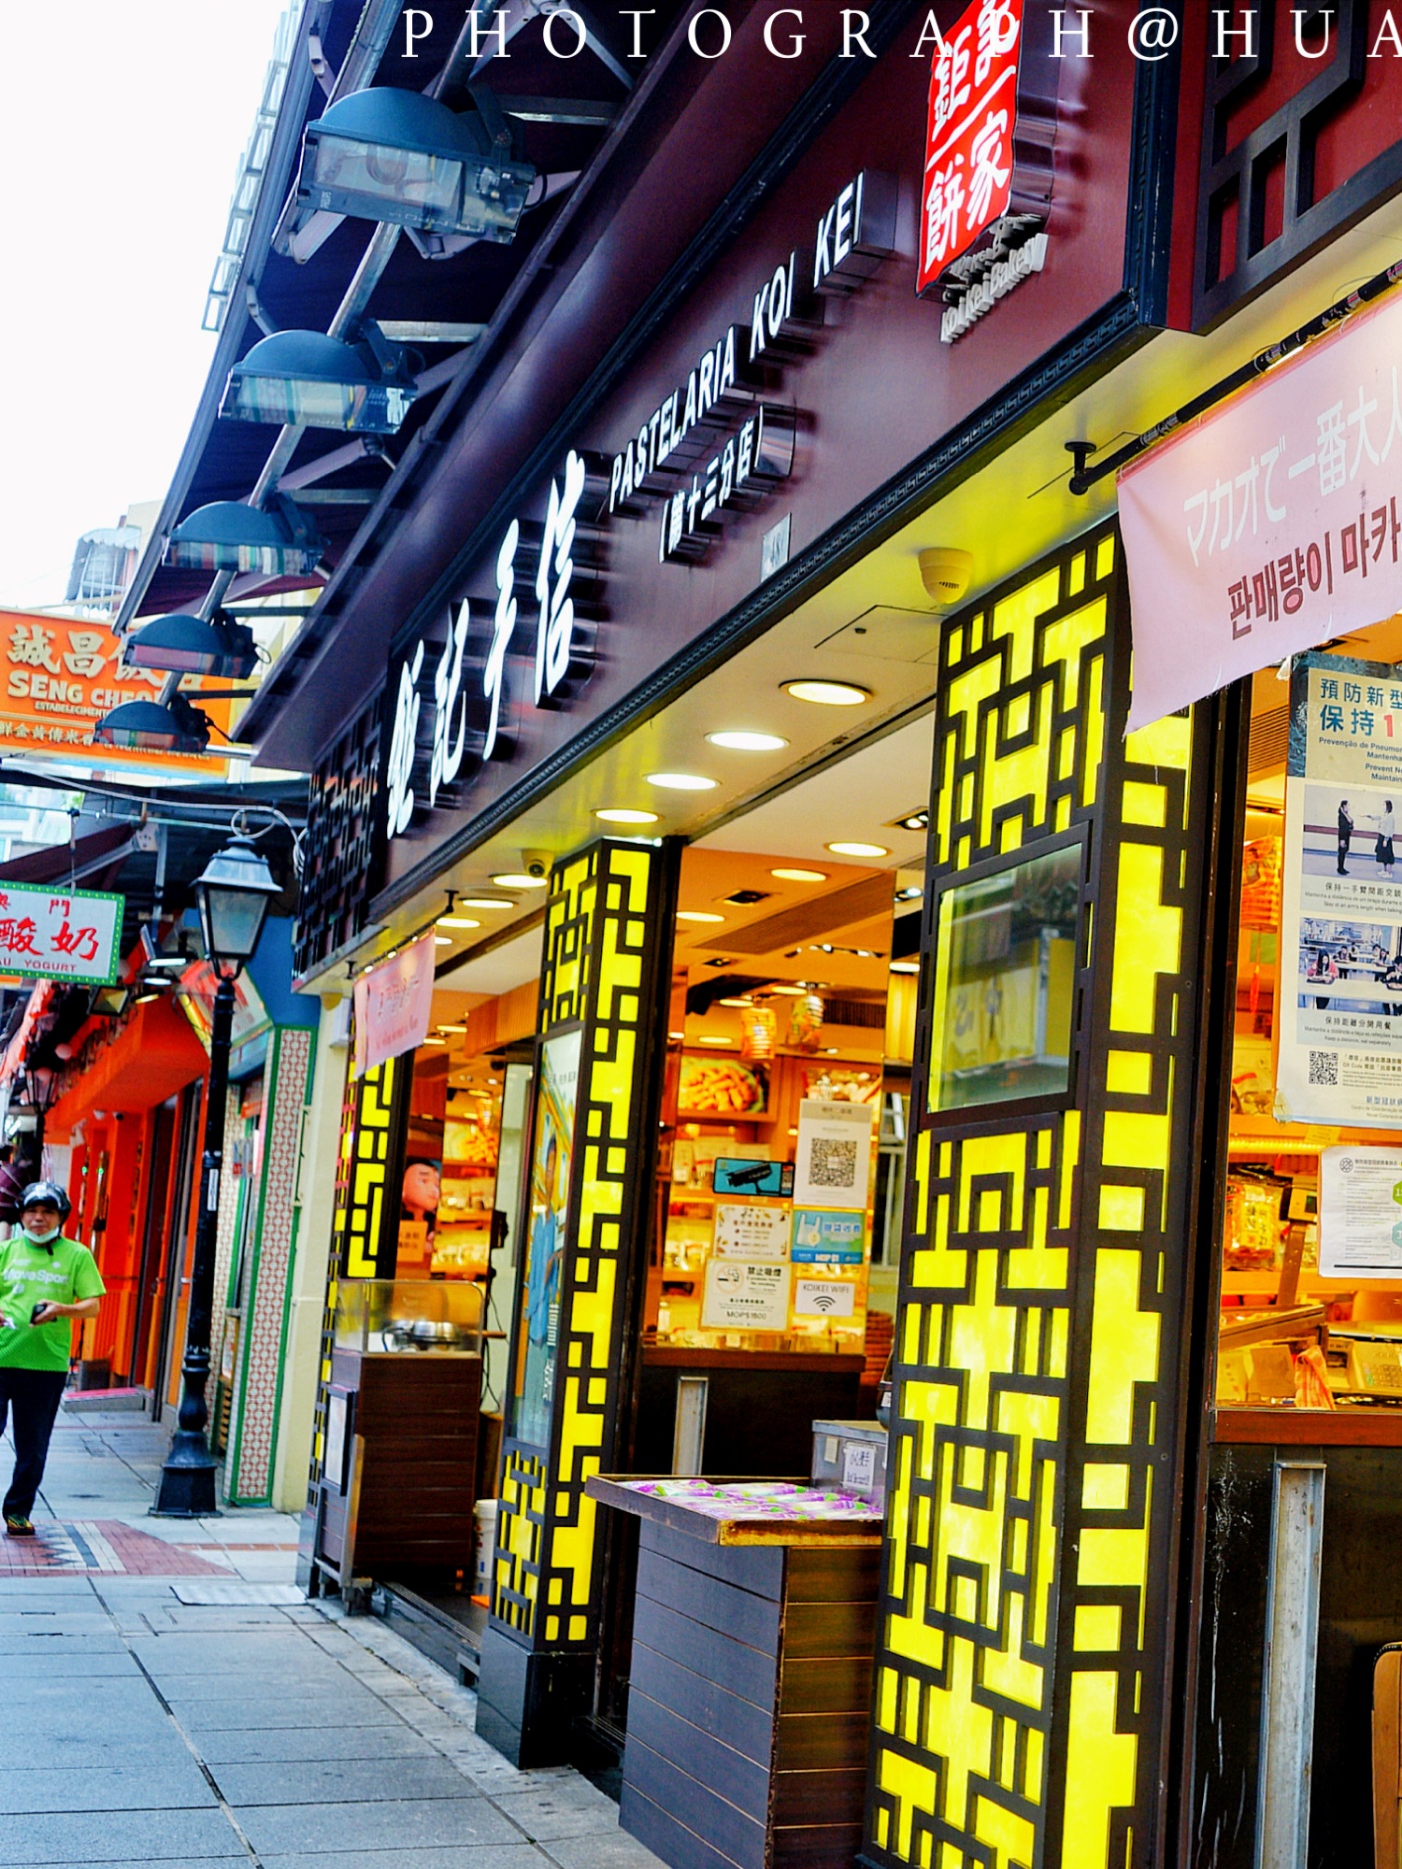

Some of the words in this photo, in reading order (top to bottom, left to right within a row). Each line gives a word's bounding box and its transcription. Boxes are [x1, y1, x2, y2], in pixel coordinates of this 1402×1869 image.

[924, 109, 1008, 274] 餅家
[609, 324, 735, 513] PASTELARIA
[749, 250, 796, 363] KOI
[814, 170, 865, 290] KEI
[1227, 531, 1333, 641] 판매량이
[8, 670, 84, 704] SENG
[1359, 741, 1369, 749] de
[1367, 751, 1402, 762] Mantenha
[1365, 763, 1393, 774] Prevent
[1371, 773, 1402, 783] Maintain
[24, 959, 76, 972] YOGURT
